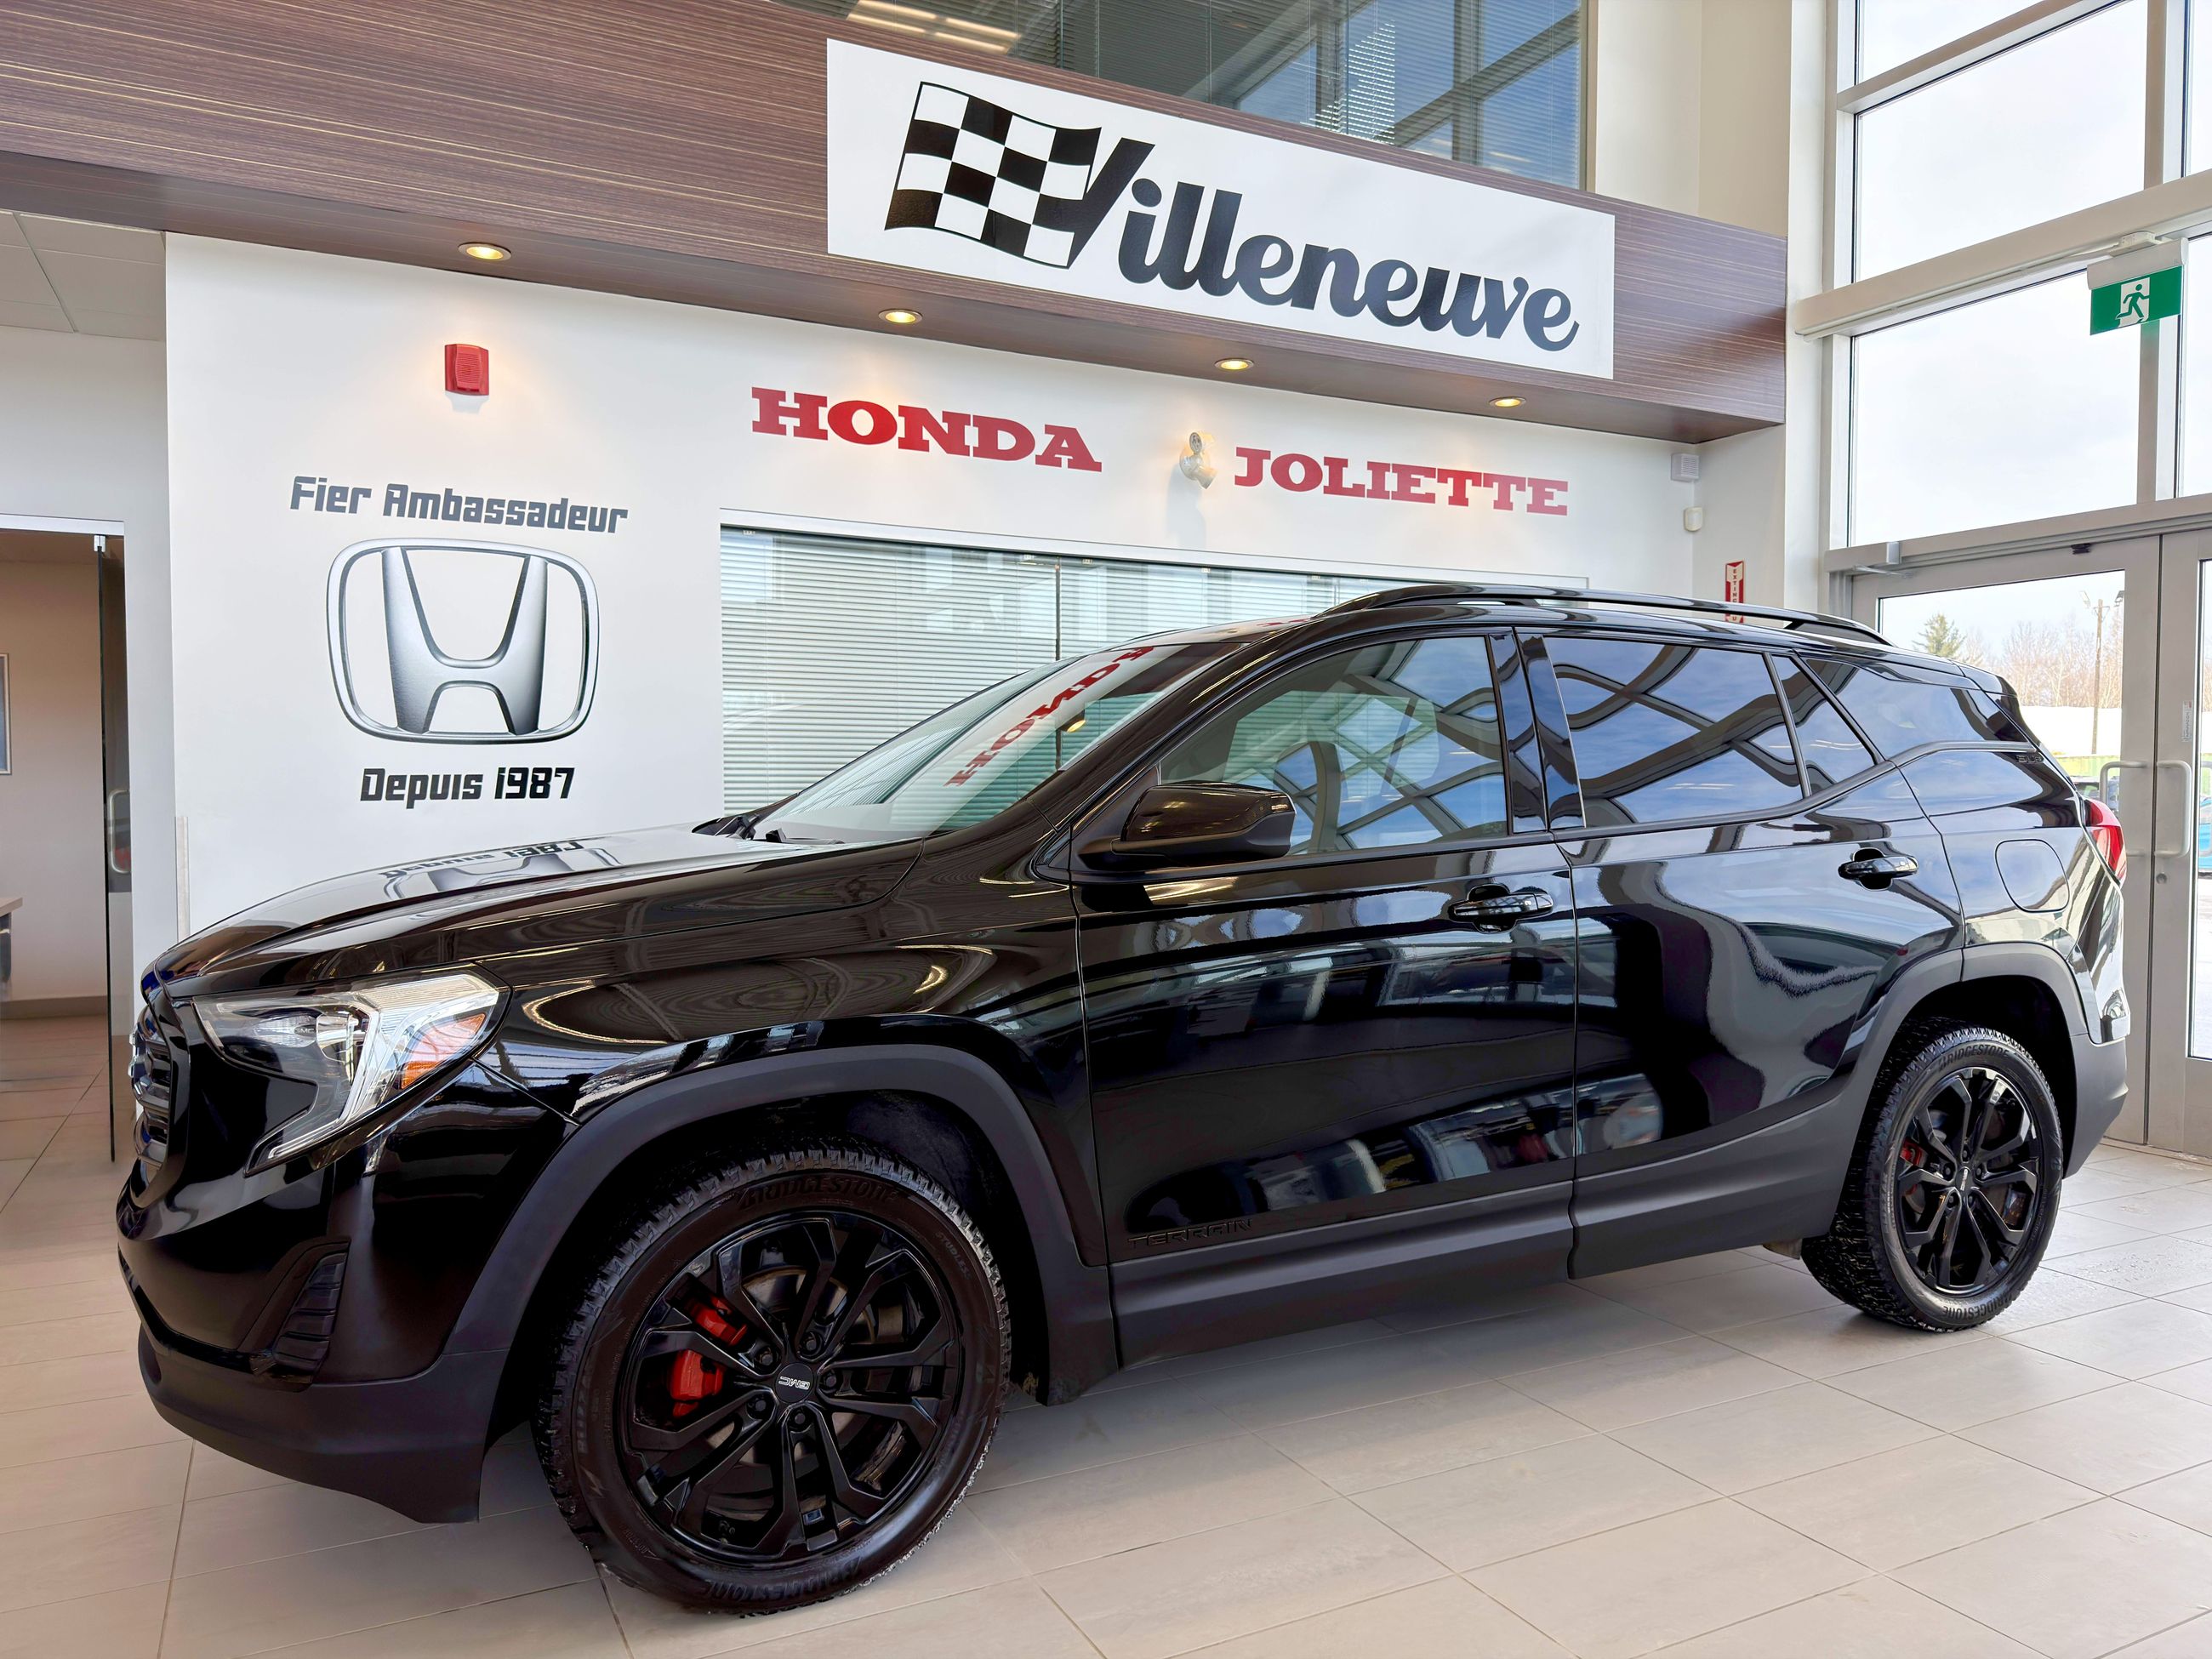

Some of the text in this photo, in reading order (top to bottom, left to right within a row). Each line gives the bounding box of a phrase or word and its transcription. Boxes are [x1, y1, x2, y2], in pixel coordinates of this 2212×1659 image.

[1067, 137, 1580, 352] Villeneuve
[751, 386, 1569, 517] HONDA JOLIETTE
[290, 475, 629, 534] Fier Ambassadeur
[360, 766, 576, 810] Depuis 1987
[1938, 1044, 2010, 1072] BRIDGESTONE
[1127, 1218, 1252, 1249] TERRAIN
[778, 1376, 811, 1390] GMC
